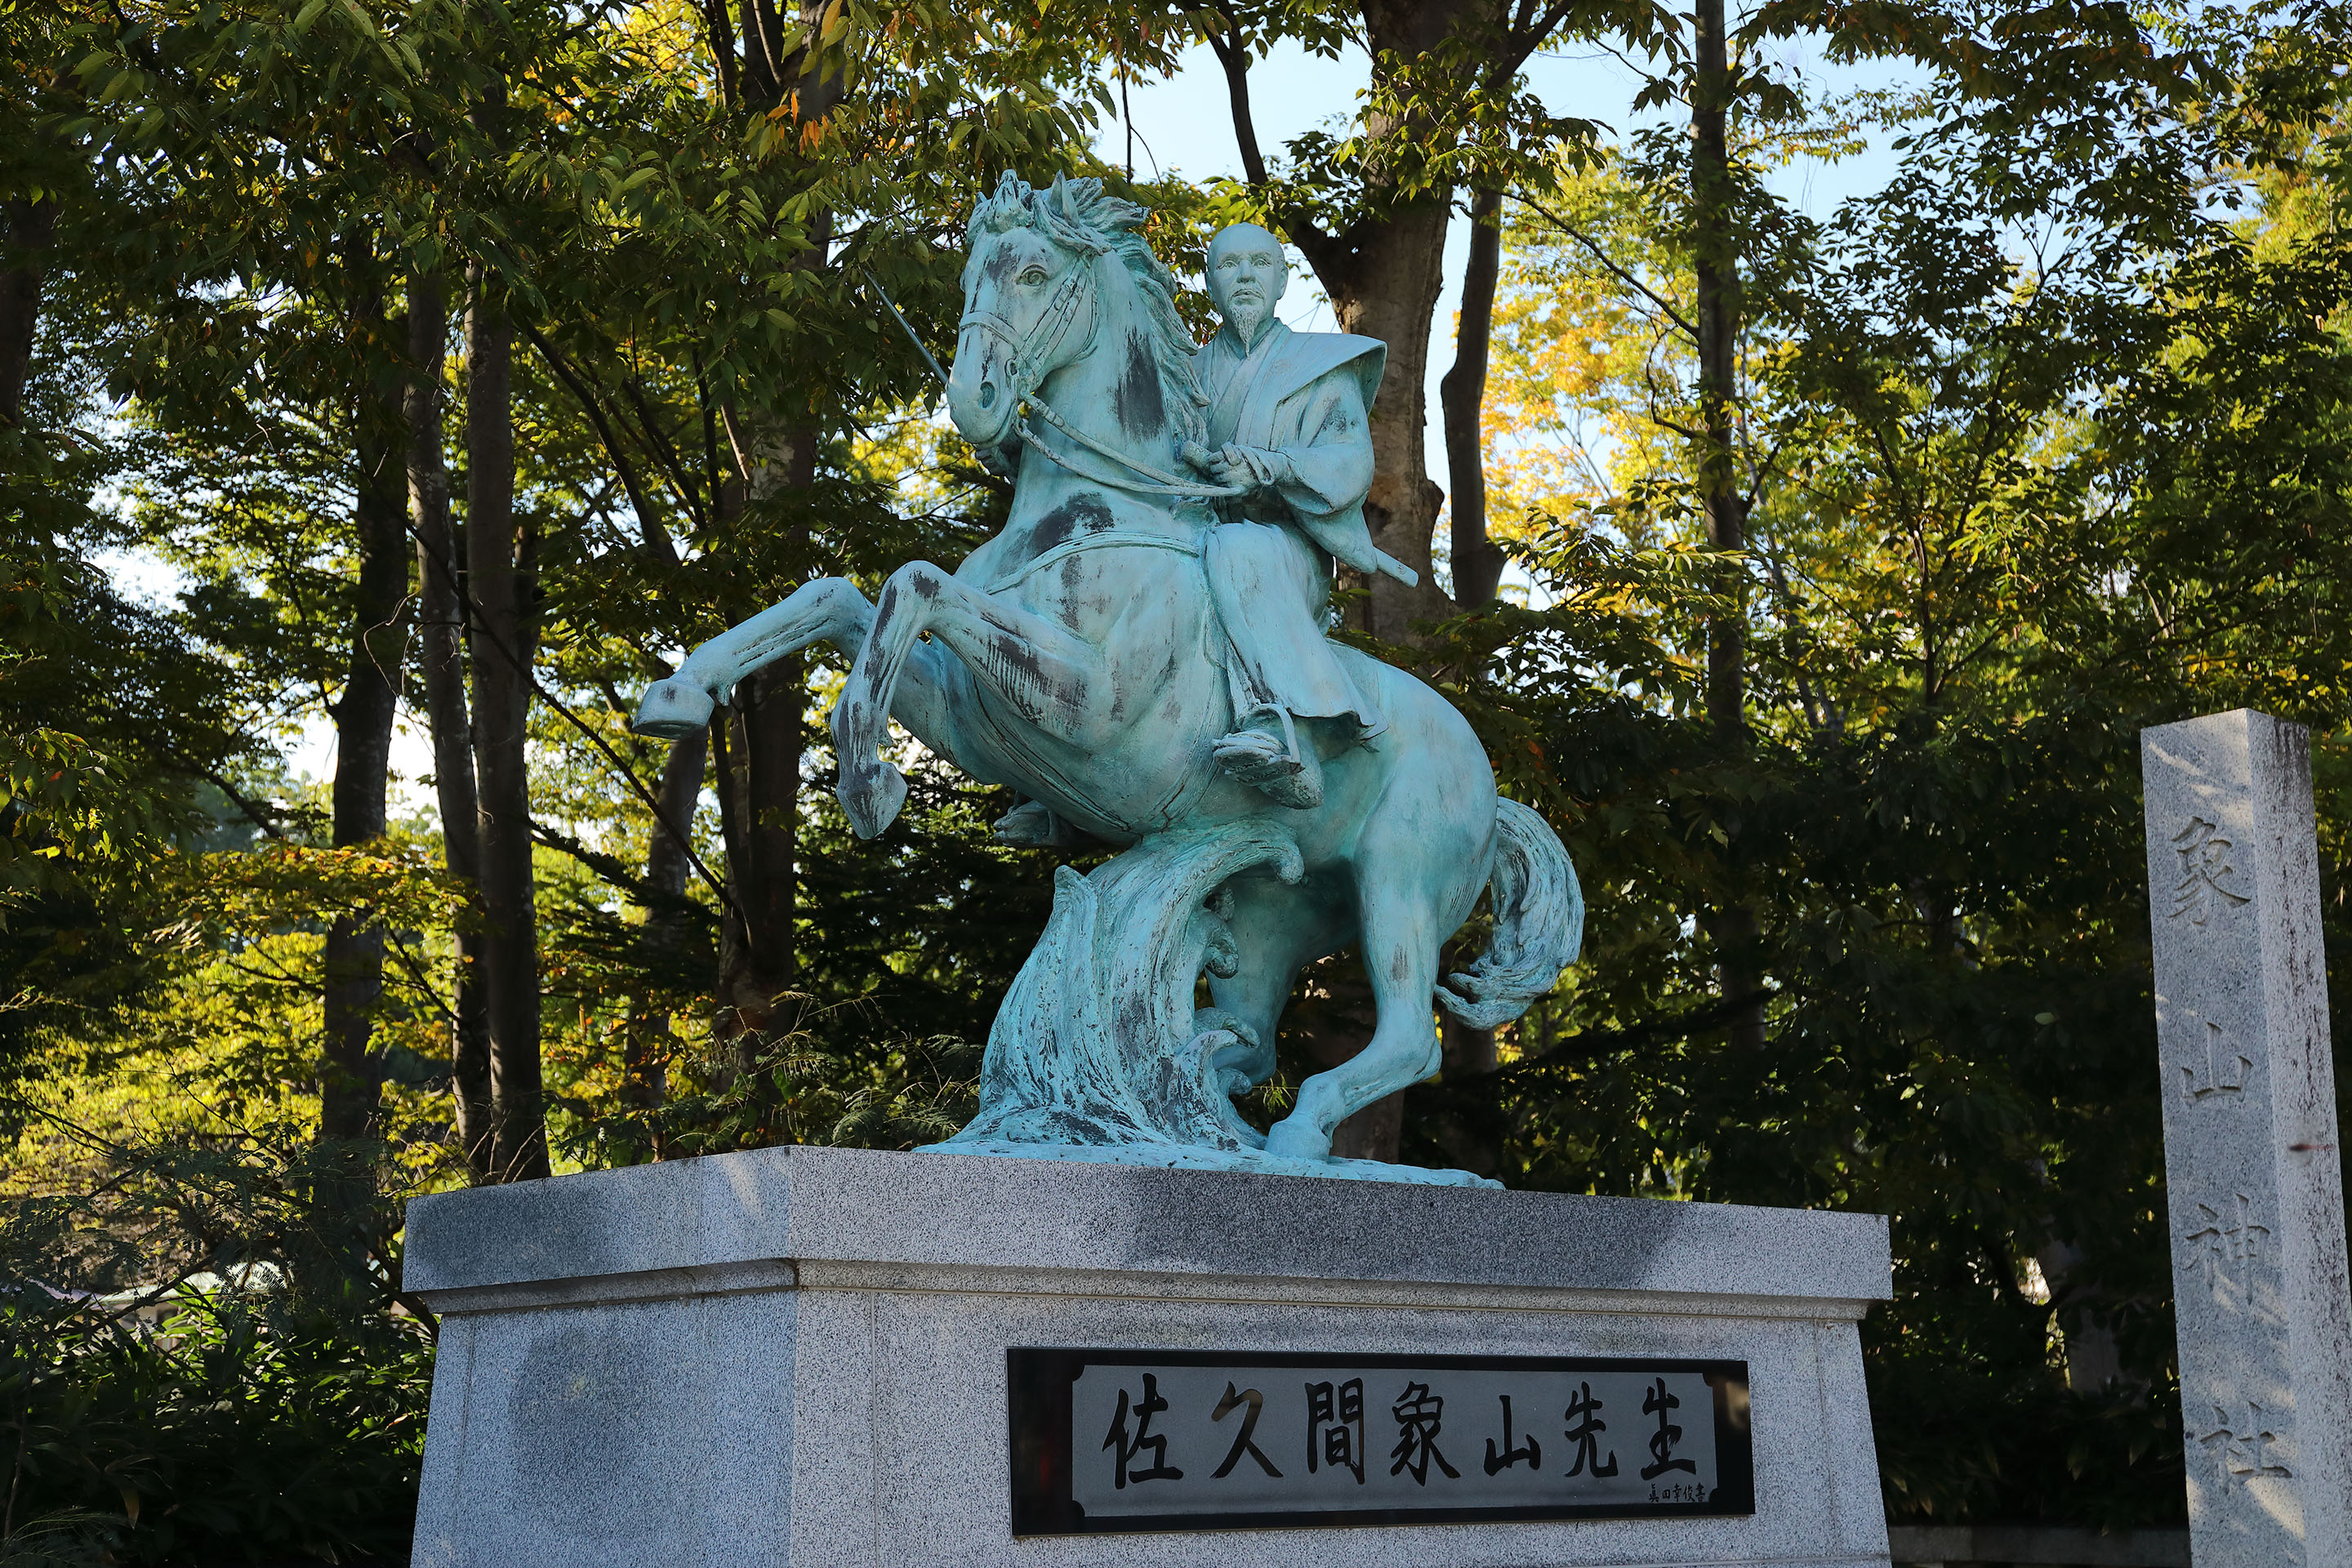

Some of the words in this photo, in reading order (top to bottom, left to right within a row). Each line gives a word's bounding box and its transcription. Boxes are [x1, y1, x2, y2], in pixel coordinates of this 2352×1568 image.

[2168, 816, 2292, 1495] 象山神社
[1102, 1372, 1698, 1490] 佐久間象山先生
